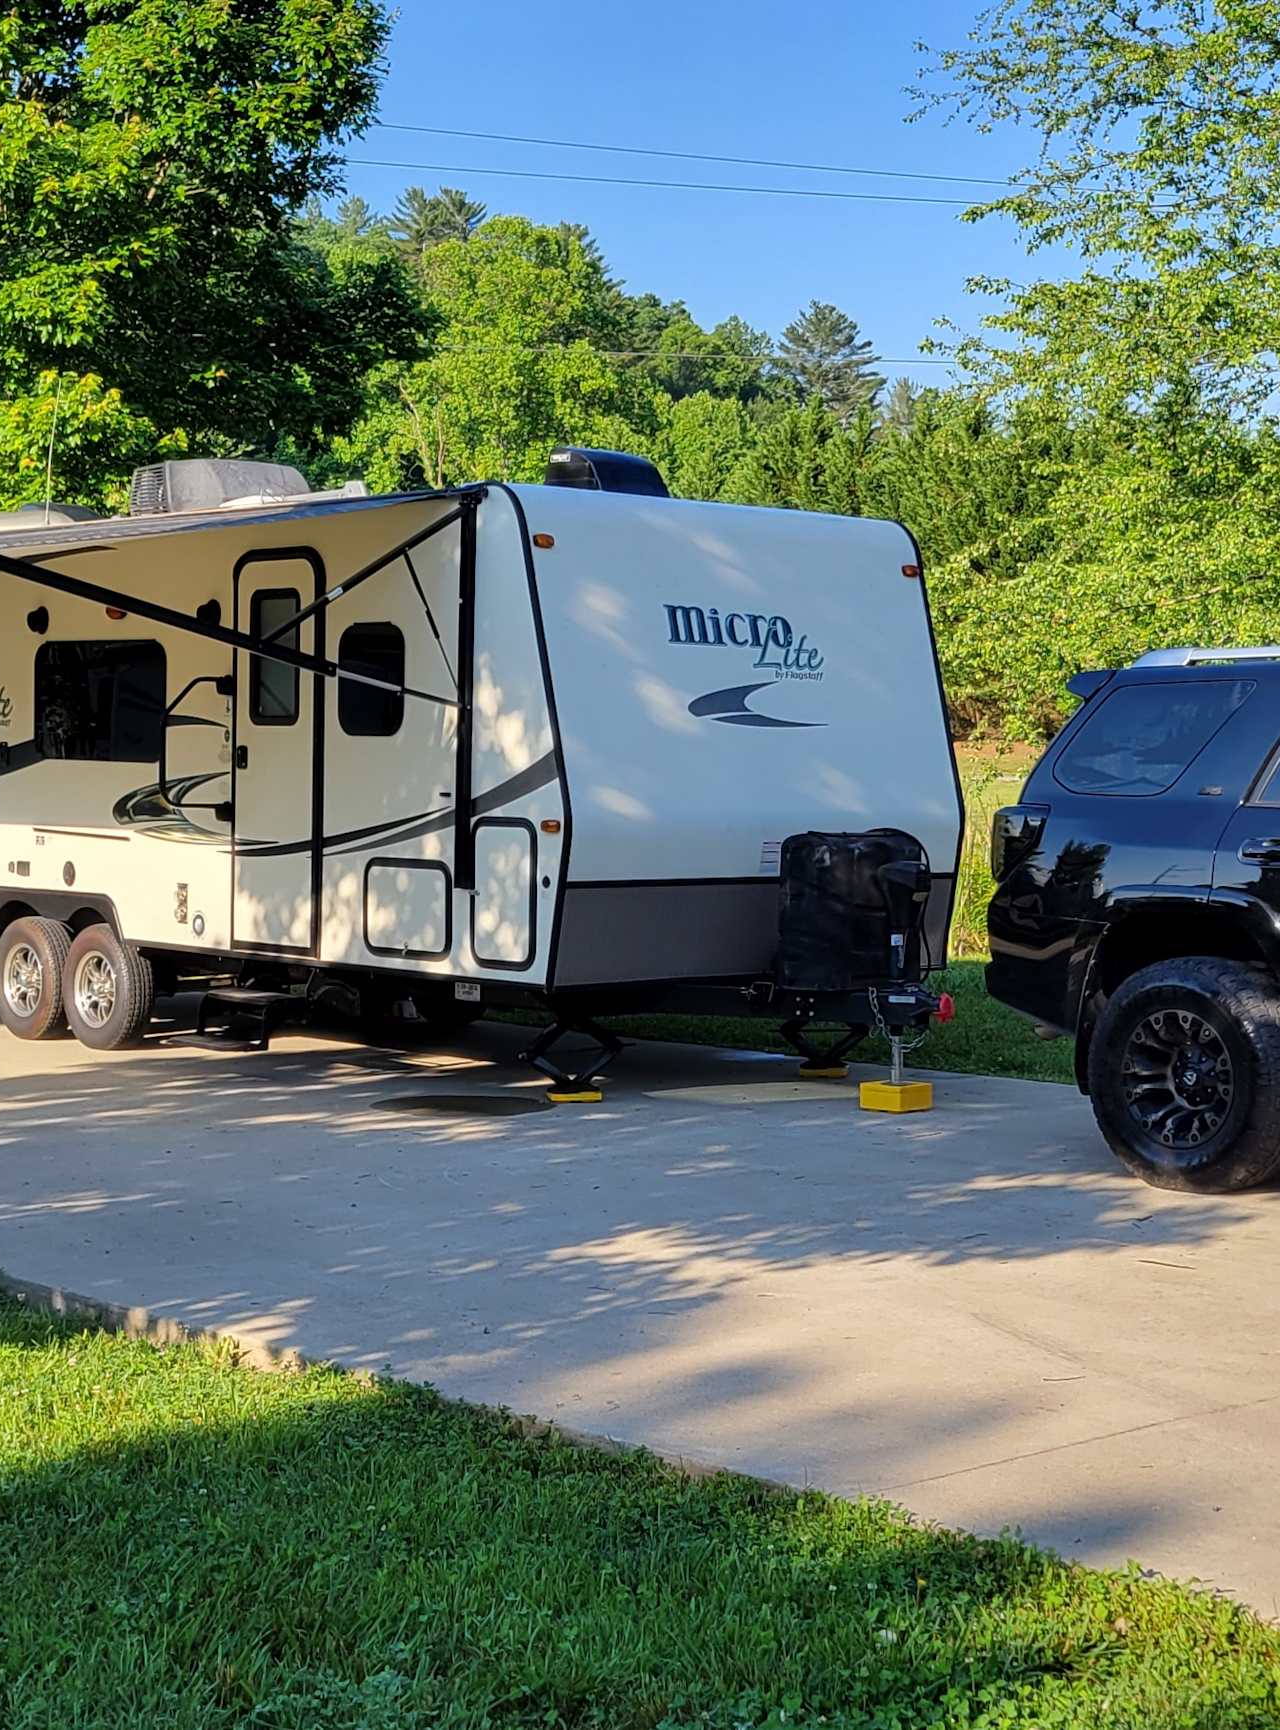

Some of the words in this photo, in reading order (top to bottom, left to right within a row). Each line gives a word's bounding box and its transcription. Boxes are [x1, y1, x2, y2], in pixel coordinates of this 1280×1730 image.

[753, 624, 825, 670] Lite
[775, 670, 784, 680] by
[785, 670, 823, 680] Flagstaff
